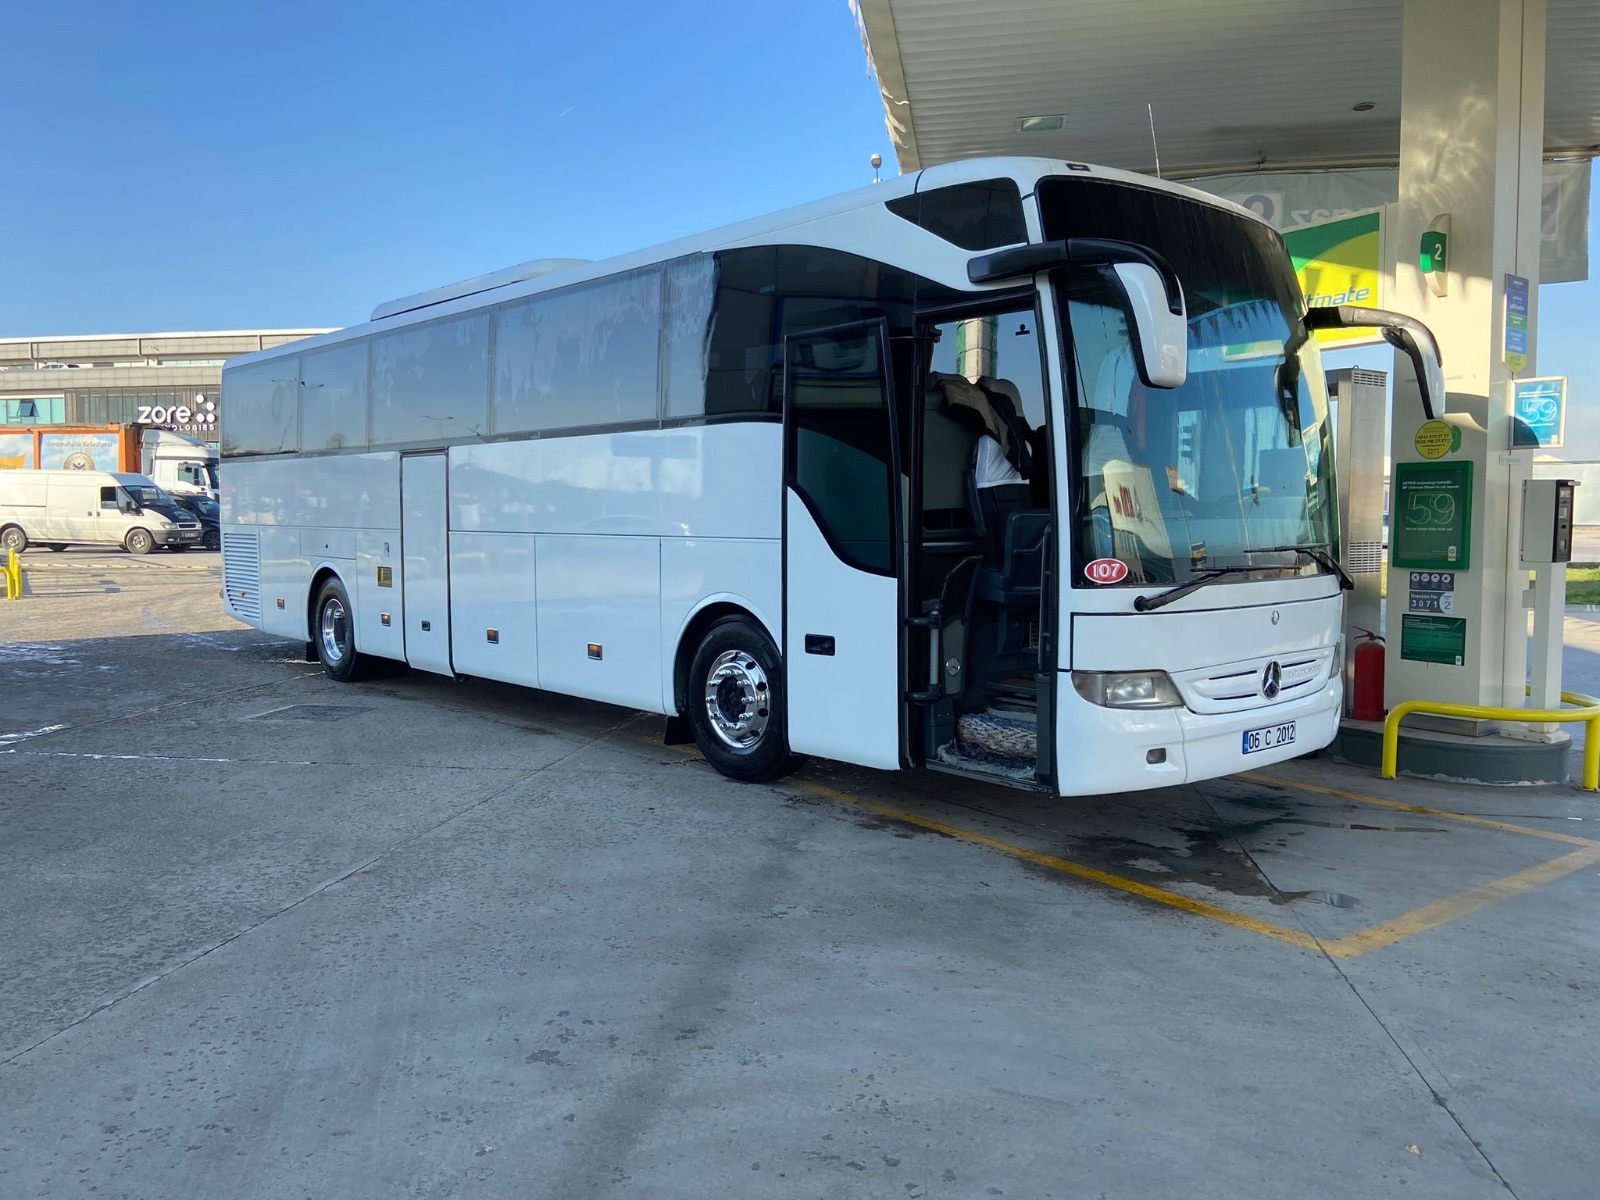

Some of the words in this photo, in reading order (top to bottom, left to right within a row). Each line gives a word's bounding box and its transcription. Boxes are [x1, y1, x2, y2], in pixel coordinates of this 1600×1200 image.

[1434, 243, 1442, 261] 2
[1304, 286, 1370, 307] timate
[137, 405, 191, 423] zore
[1522, 398, 1557, 422] 59
[1405, 491, 1455, 525] 59
[1091, 563, 1120, 577] 107
[1444, 601, 1451, 610] 2
[1249, 732, 1260, 749] 06
[1265, 729, 1272, 746] C
[1276, 724, 1295, 744] 2012
